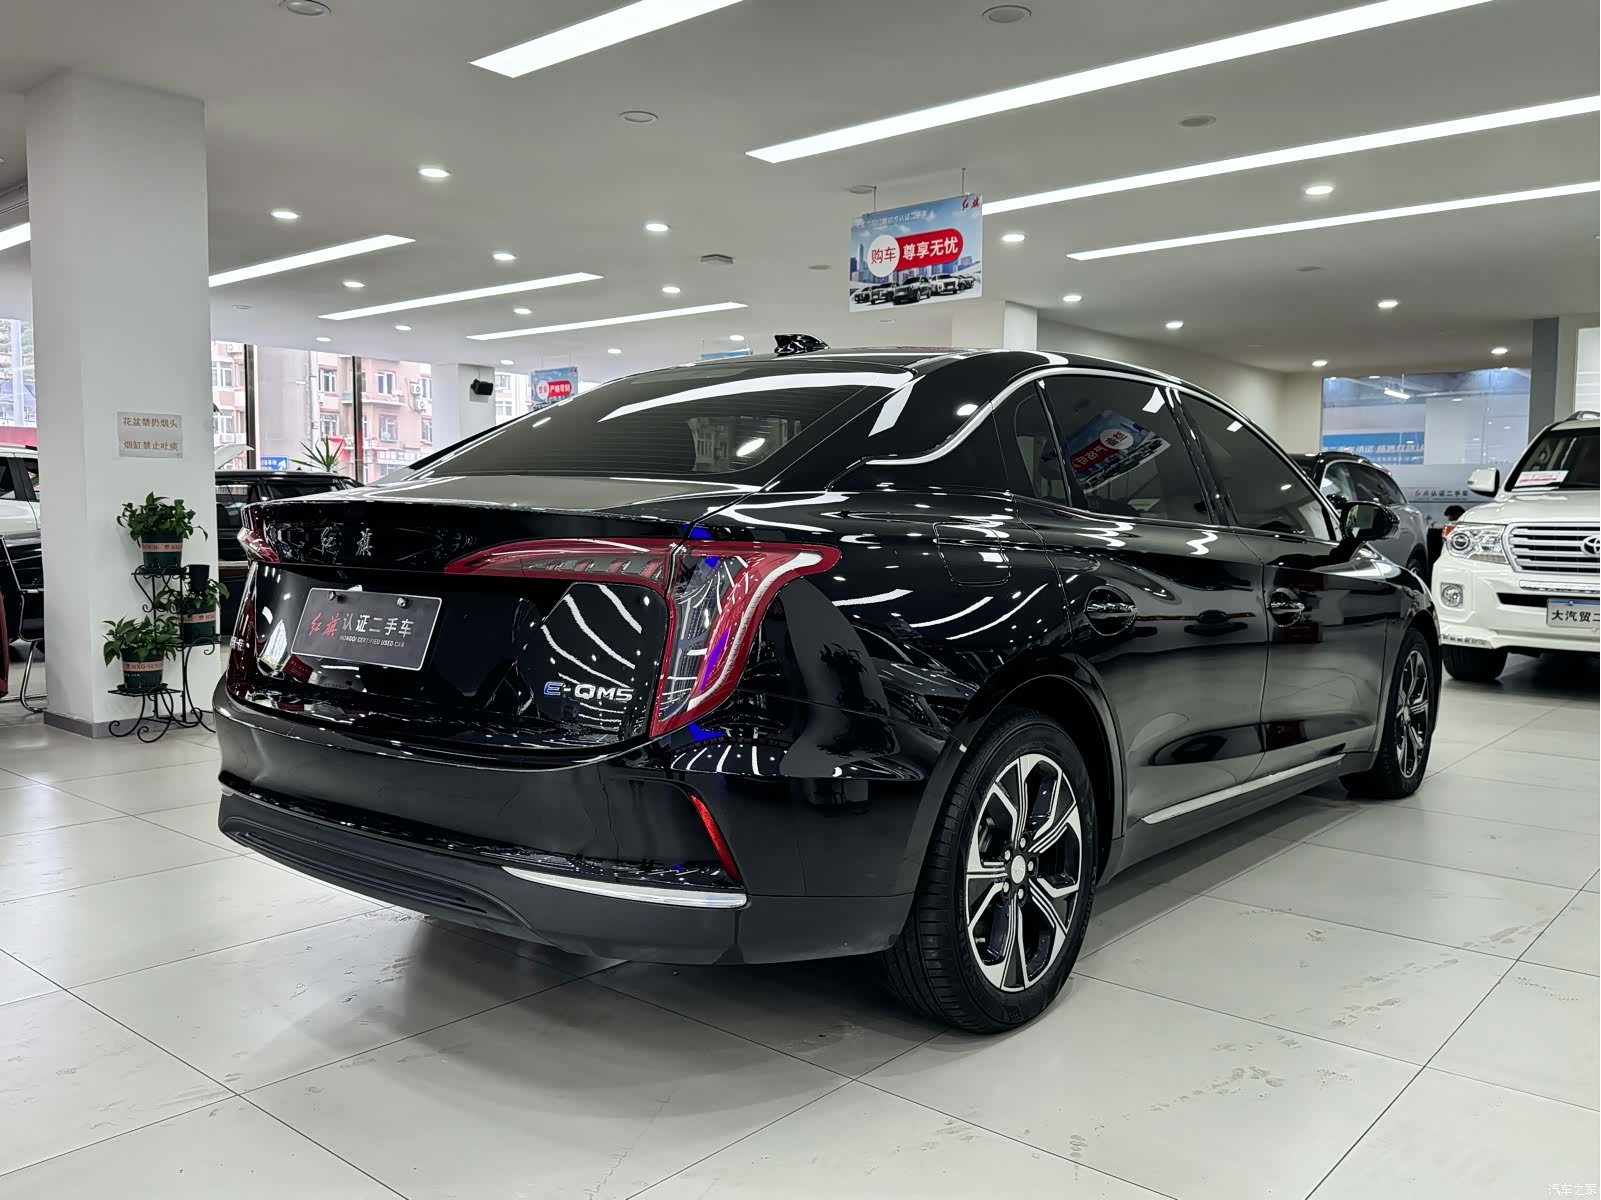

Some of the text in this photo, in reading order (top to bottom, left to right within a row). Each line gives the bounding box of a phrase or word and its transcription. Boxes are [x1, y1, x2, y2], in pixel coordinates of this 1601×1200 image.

[871, 236, 959, 264] 购车 尊享无忧
[122, 416, 178, 428] 花盆禁扔烟头
[123, 440, 179, 451] 烟缸禁止吐痰
[357, 637, 381, 645] CERTIFIED
[380, 639, 394, 647] USED
[543, 681, 634, 702] E-QM5
